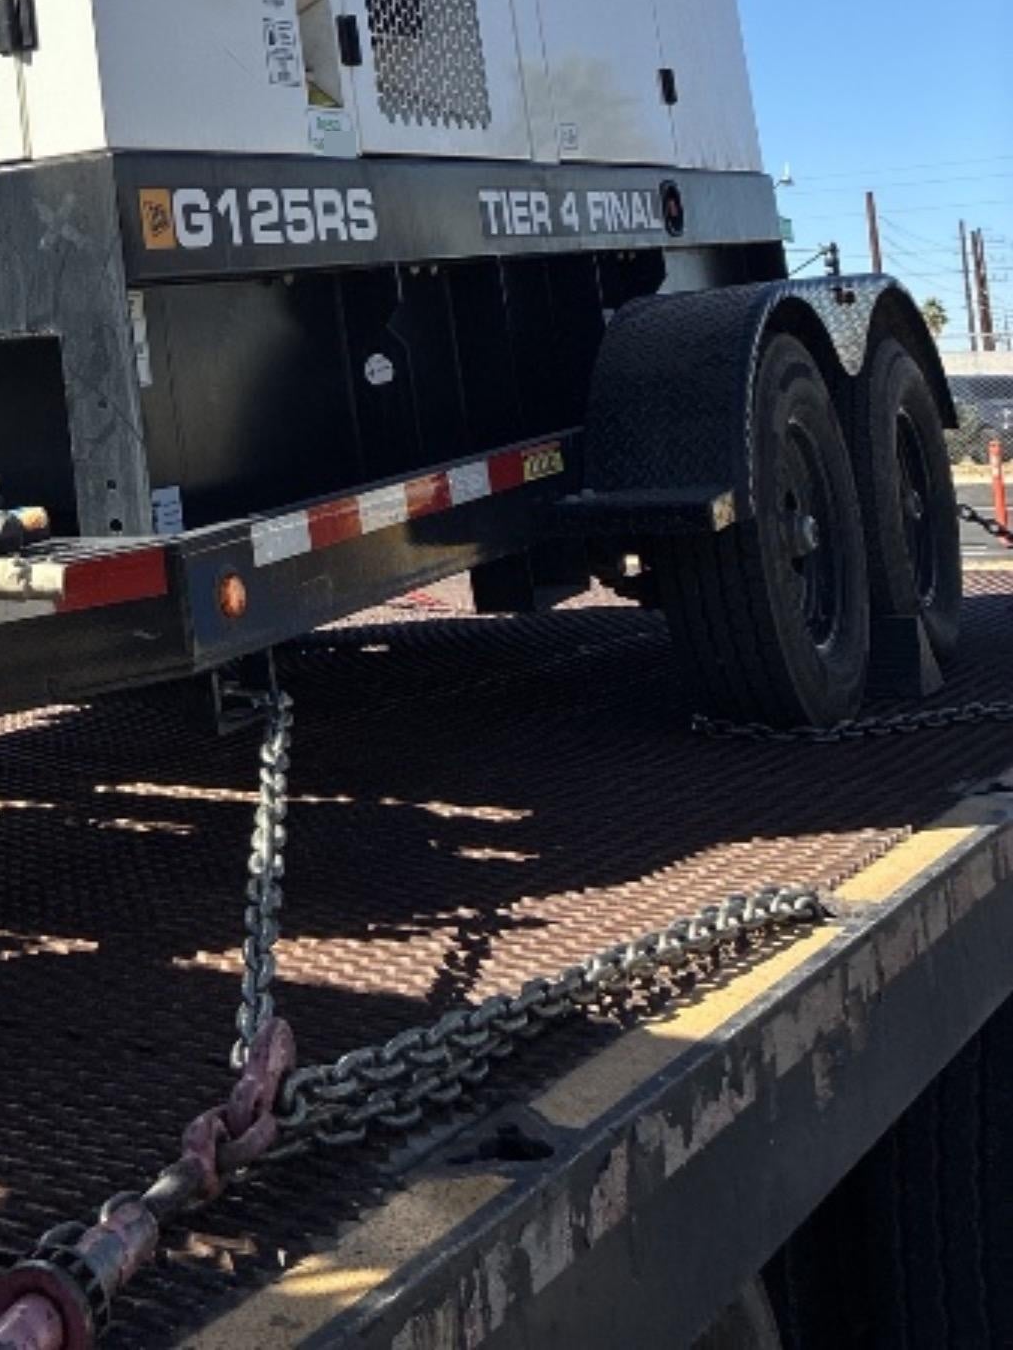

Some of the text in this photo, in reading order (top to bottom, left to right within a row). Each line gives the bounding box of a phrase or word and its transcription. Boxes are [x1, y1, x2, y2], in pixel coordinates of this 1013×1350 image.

[172, 187, 379, 248] G125RS
[478, 189, 665, 236] TIER 4 FINAL
